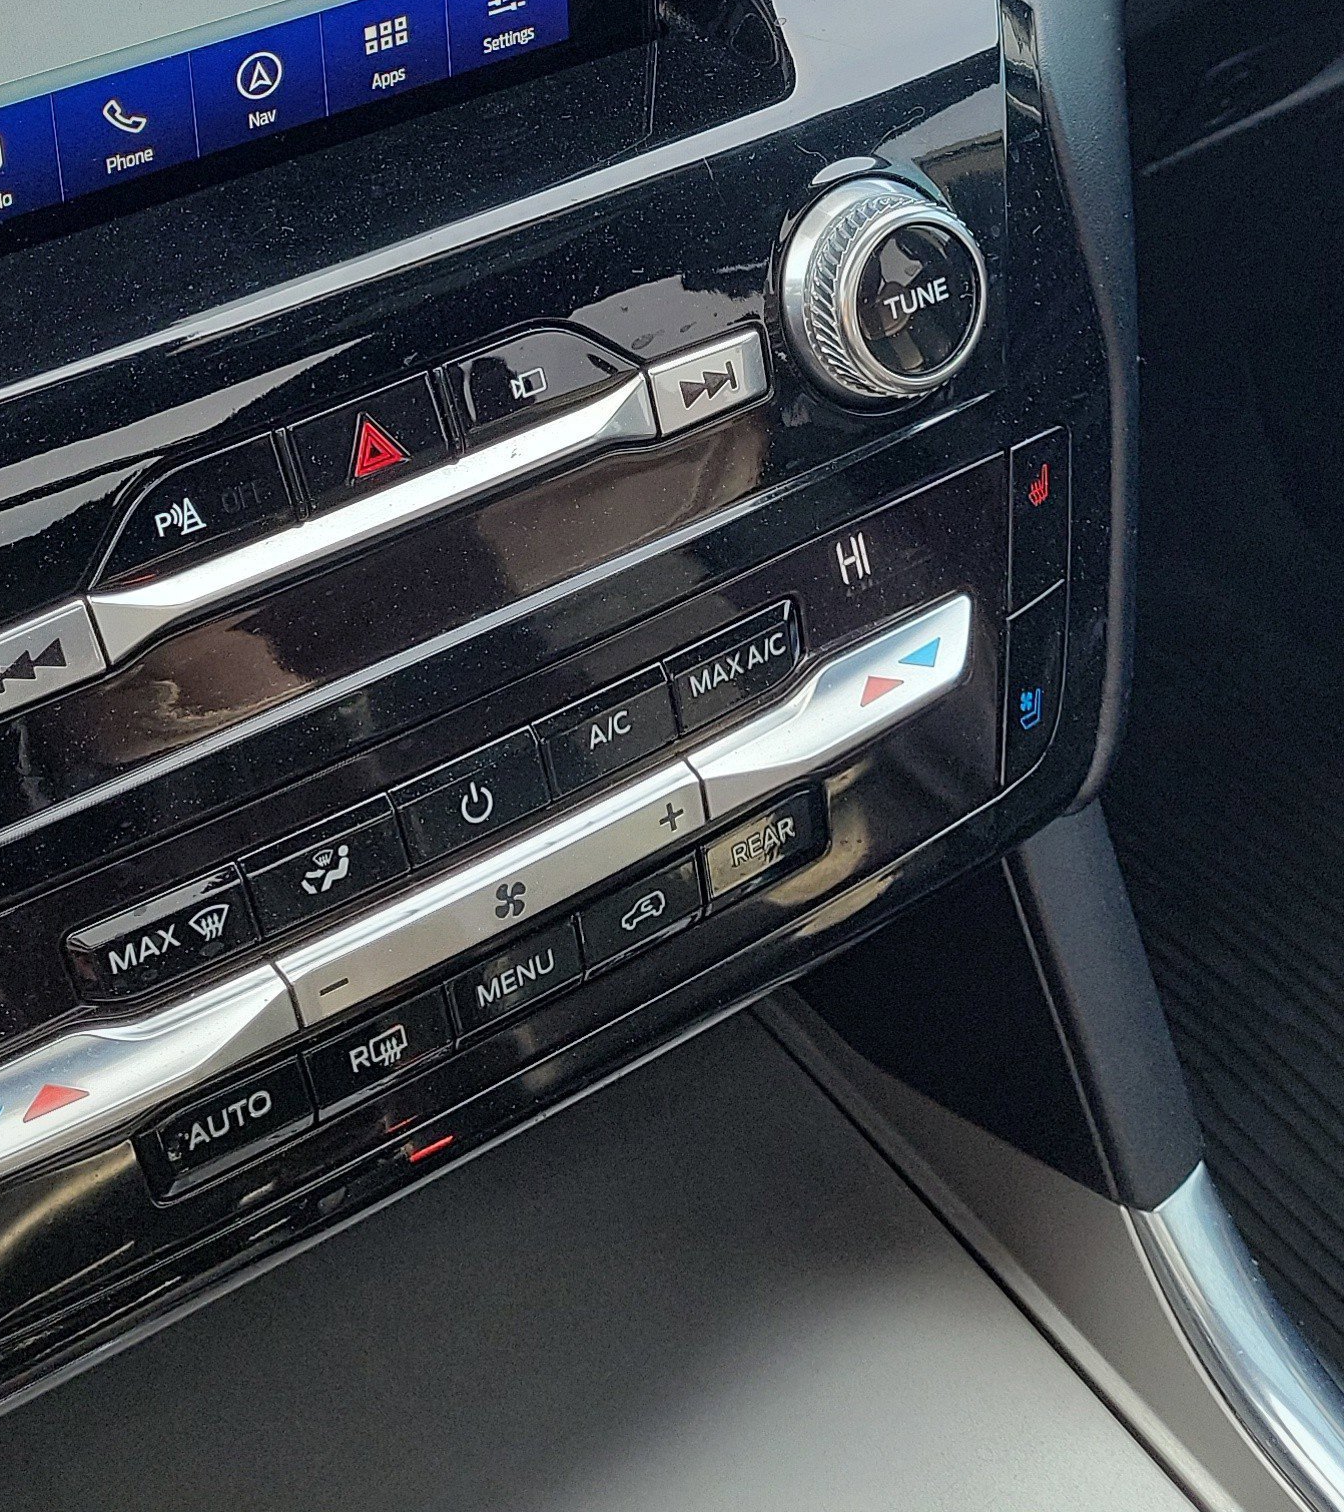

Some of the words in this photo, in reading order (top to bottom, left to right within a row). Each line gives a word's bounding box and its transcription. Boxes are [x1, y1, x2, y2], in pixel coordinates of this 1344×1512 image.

[483, 27, 535, 55] Settings
[371, 67, 407, 90] Apps
[248, 109, 277, 130] Nav
[105, 147, 154, 175] Phone
[883, 277, 950, 320] TUNE
[835, 531, 871, 585] HI
[689, 652, 745, 698] MAX
[747, 632, 787, 670] A/C
[589, 710, 632, 750] A/C
[732, 817, 796, 867] REAR
[108, 924, 181, 974] MAX
[477, 947, 556, 1009] MENU
[188, 1090, 272, 1151] AUTO
